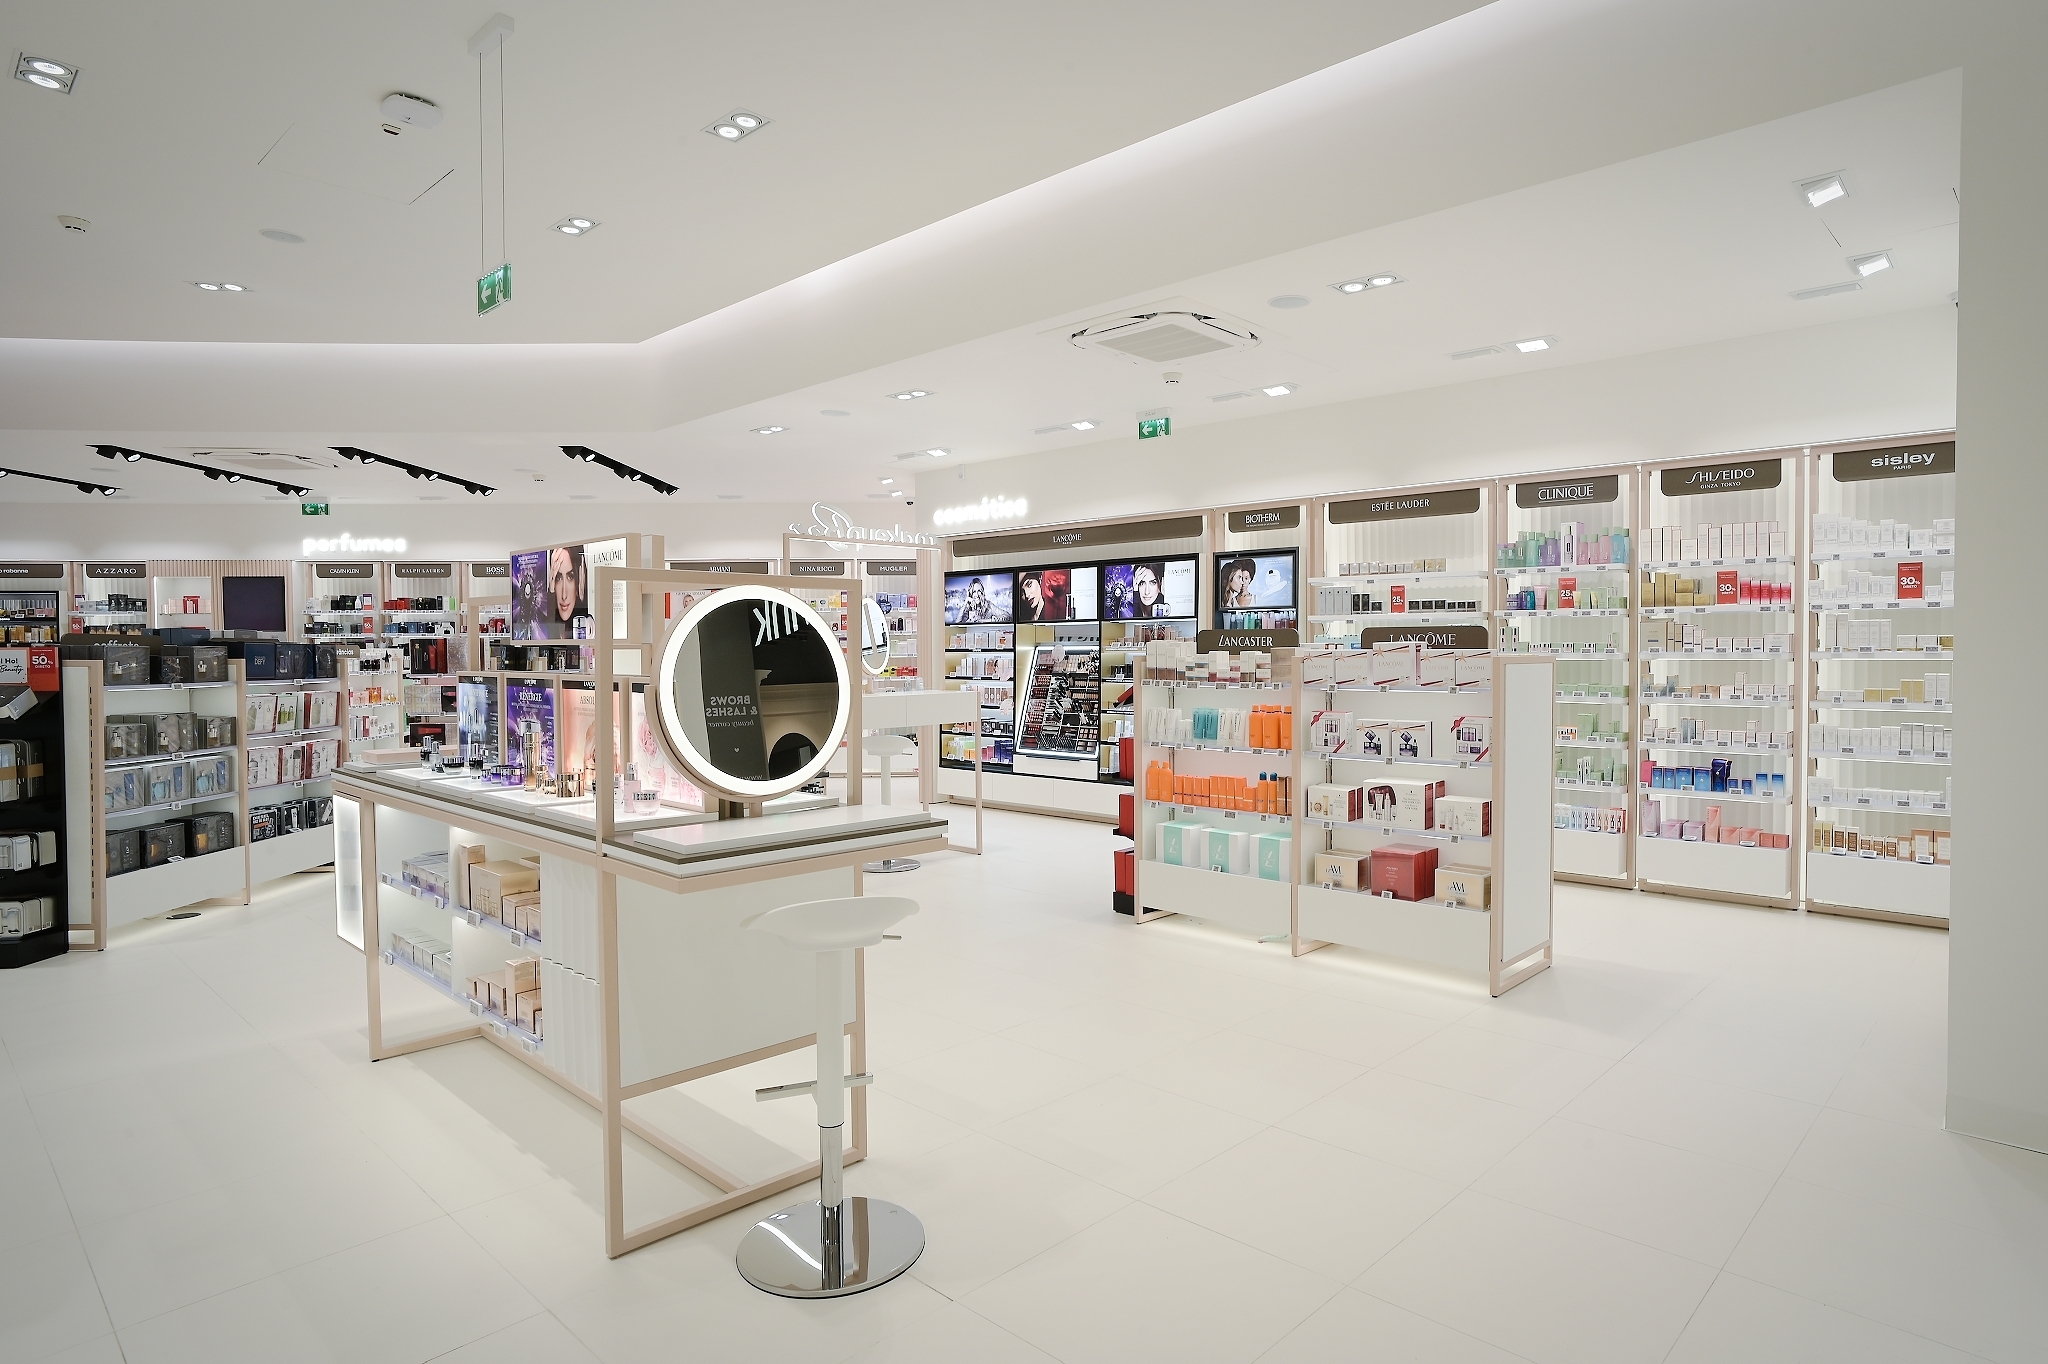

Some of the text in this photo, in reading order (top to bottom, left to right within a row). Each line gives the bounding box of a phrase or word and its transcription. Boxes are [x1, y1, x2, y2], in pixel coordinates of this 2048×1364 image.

[1871, 452, 1936, 467] sisley
[1685, 468, 1755, 484] SHISEIDO
[1538, 485, 1594, 500] CLINIQUE
[1371, 499, 1430, 512] ESTÉE LAUDER
[1245, 512, 1281, 524] BIOTHERM
[302, 532, 407, 557] perfumes
[1053, 533, 1082, 543] LANCÔME
[593, 549, 624, 564] LANCÔME
[95, 567, 138, 575] AZZARO
[1218, 634, 1274, 647] LANCASTER
[1389, 632, 1457, 646] LANCÔME
[32, 655, 54, 665] 50%
